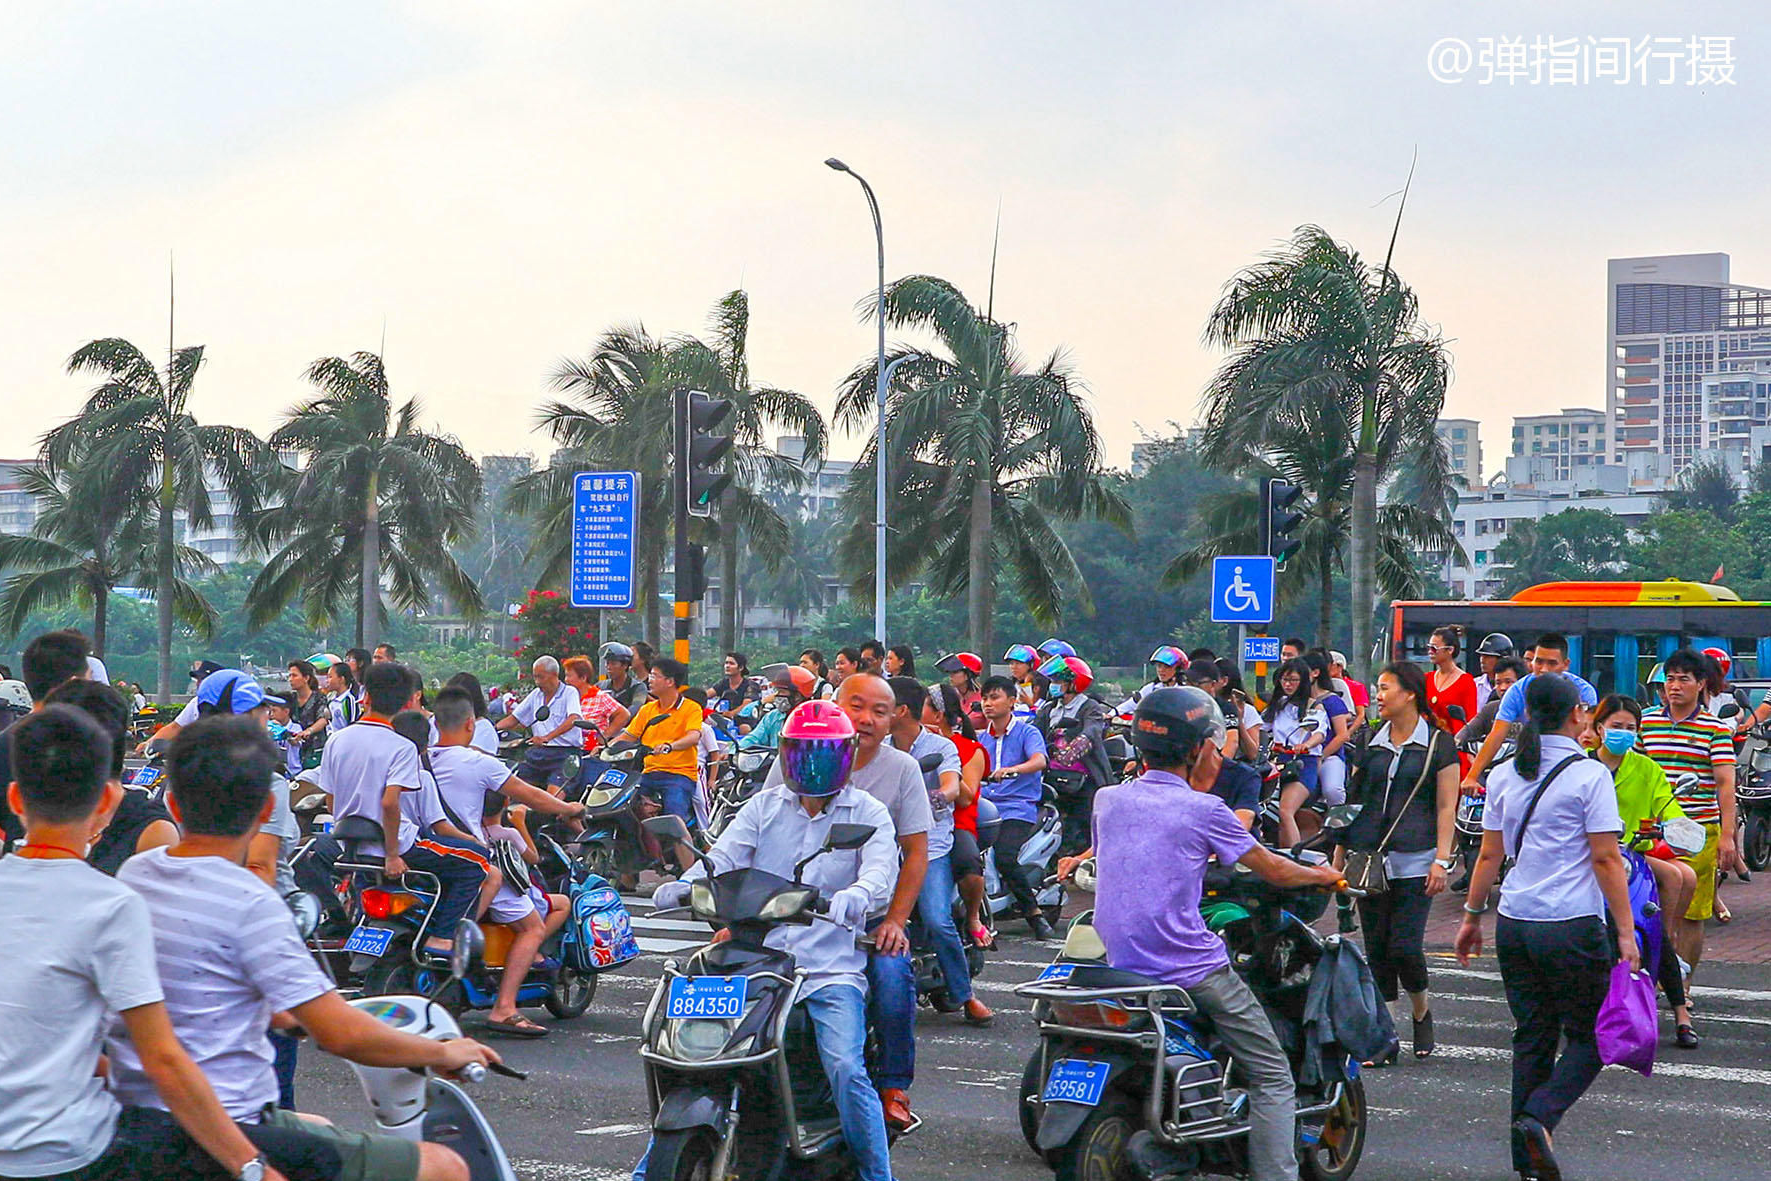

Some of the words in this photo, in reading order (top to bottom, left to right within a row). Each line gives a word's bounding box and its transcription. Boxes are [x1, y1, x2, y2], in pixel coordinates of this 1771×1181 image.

[581, 478, 627, 491] 温馨提示
[348, 938, 383, 953] 701226
[673, 997, 739, 1015] 884350
